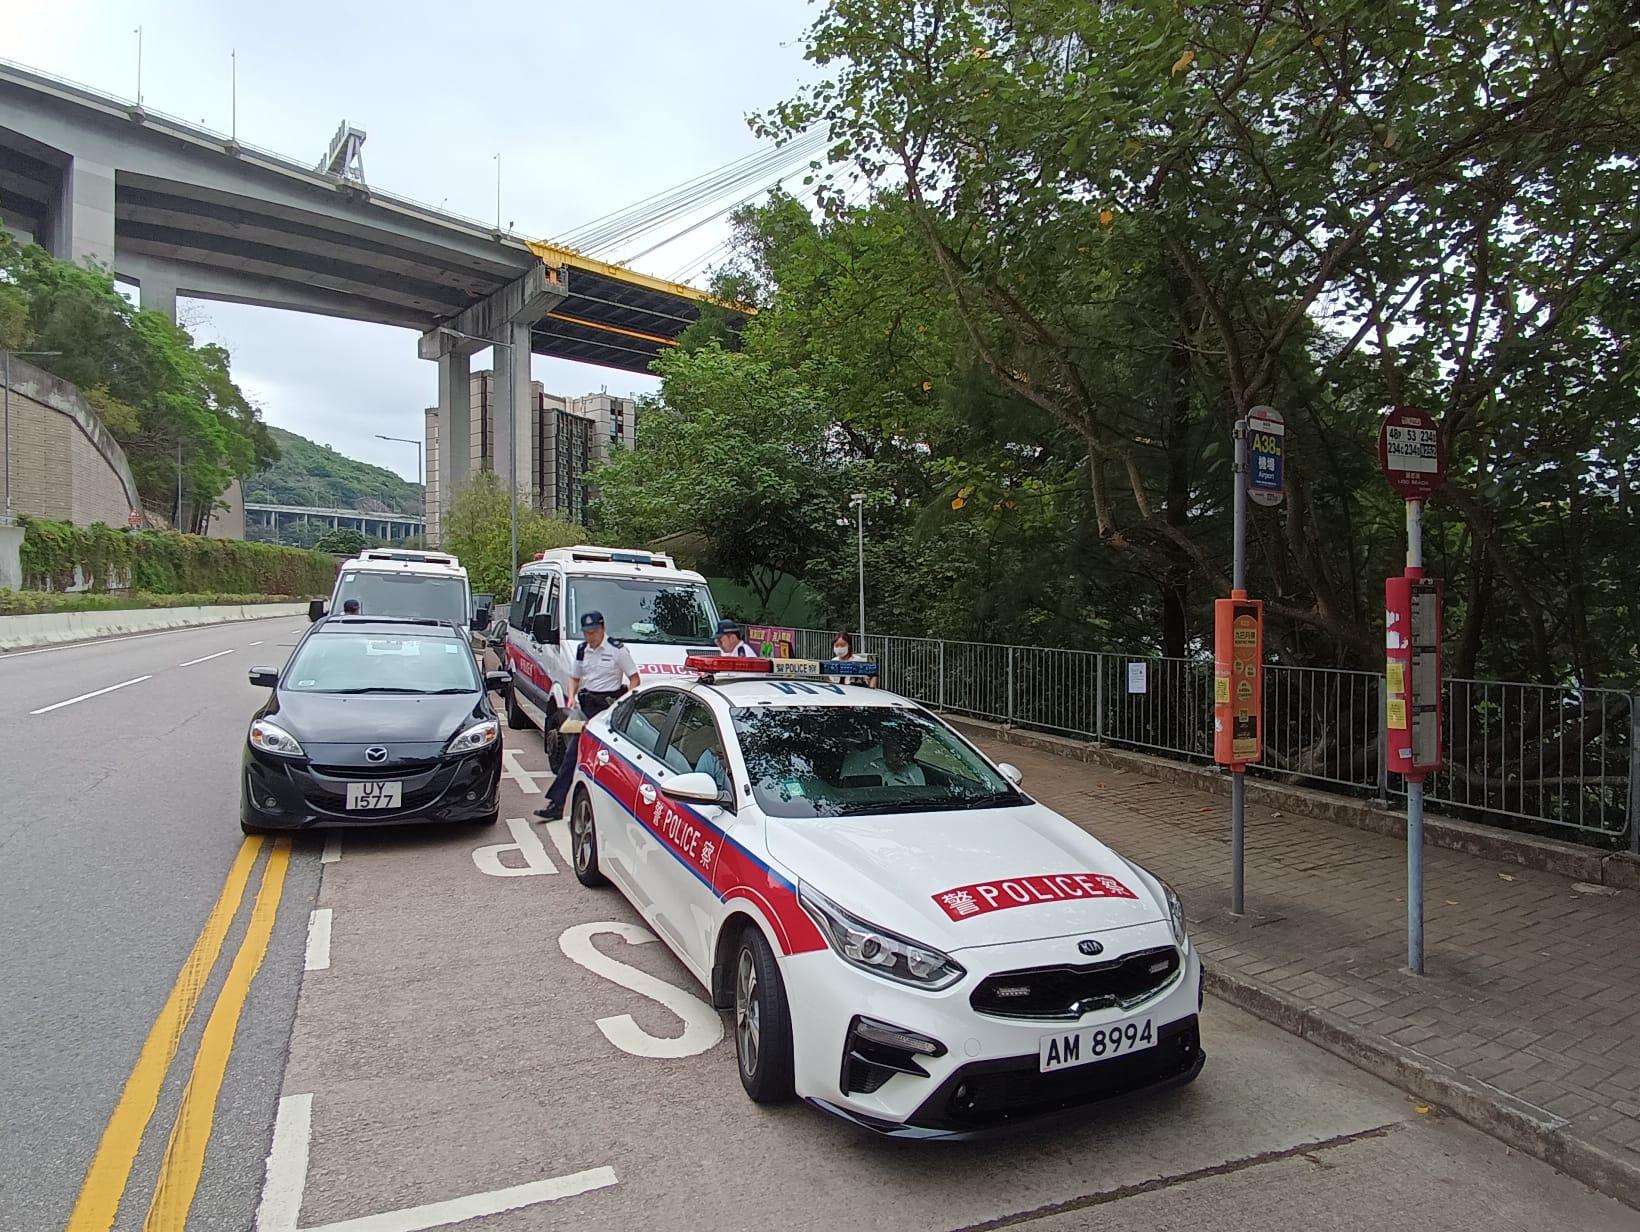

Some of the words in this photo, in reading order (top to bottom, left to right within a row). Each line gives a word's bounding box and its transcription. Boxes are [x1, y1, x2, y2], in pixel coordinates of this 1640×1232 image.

[1407, 429, 1417, 441] 53
[1258, 471, 1275, 480] Airport
[785, 664, 808, 674] POLICE
[363, 783, 385, 796] UY
[354, 795, 393, 809] 1577
[652, 801, 664, 828] 警
[663, 812, 701, 859] POLICE
[700, 841, 716, 870] 察
[942, 890, 980, 916] 警
[976, 876, 1103, 908] POLICE
[1098, 876, 1128, 895] 察
[1081, 943, 1102, 953] KIA
[1046, 1034, 1081, 1067] AM
[1091, 1020, 1153, 1057] 8994
